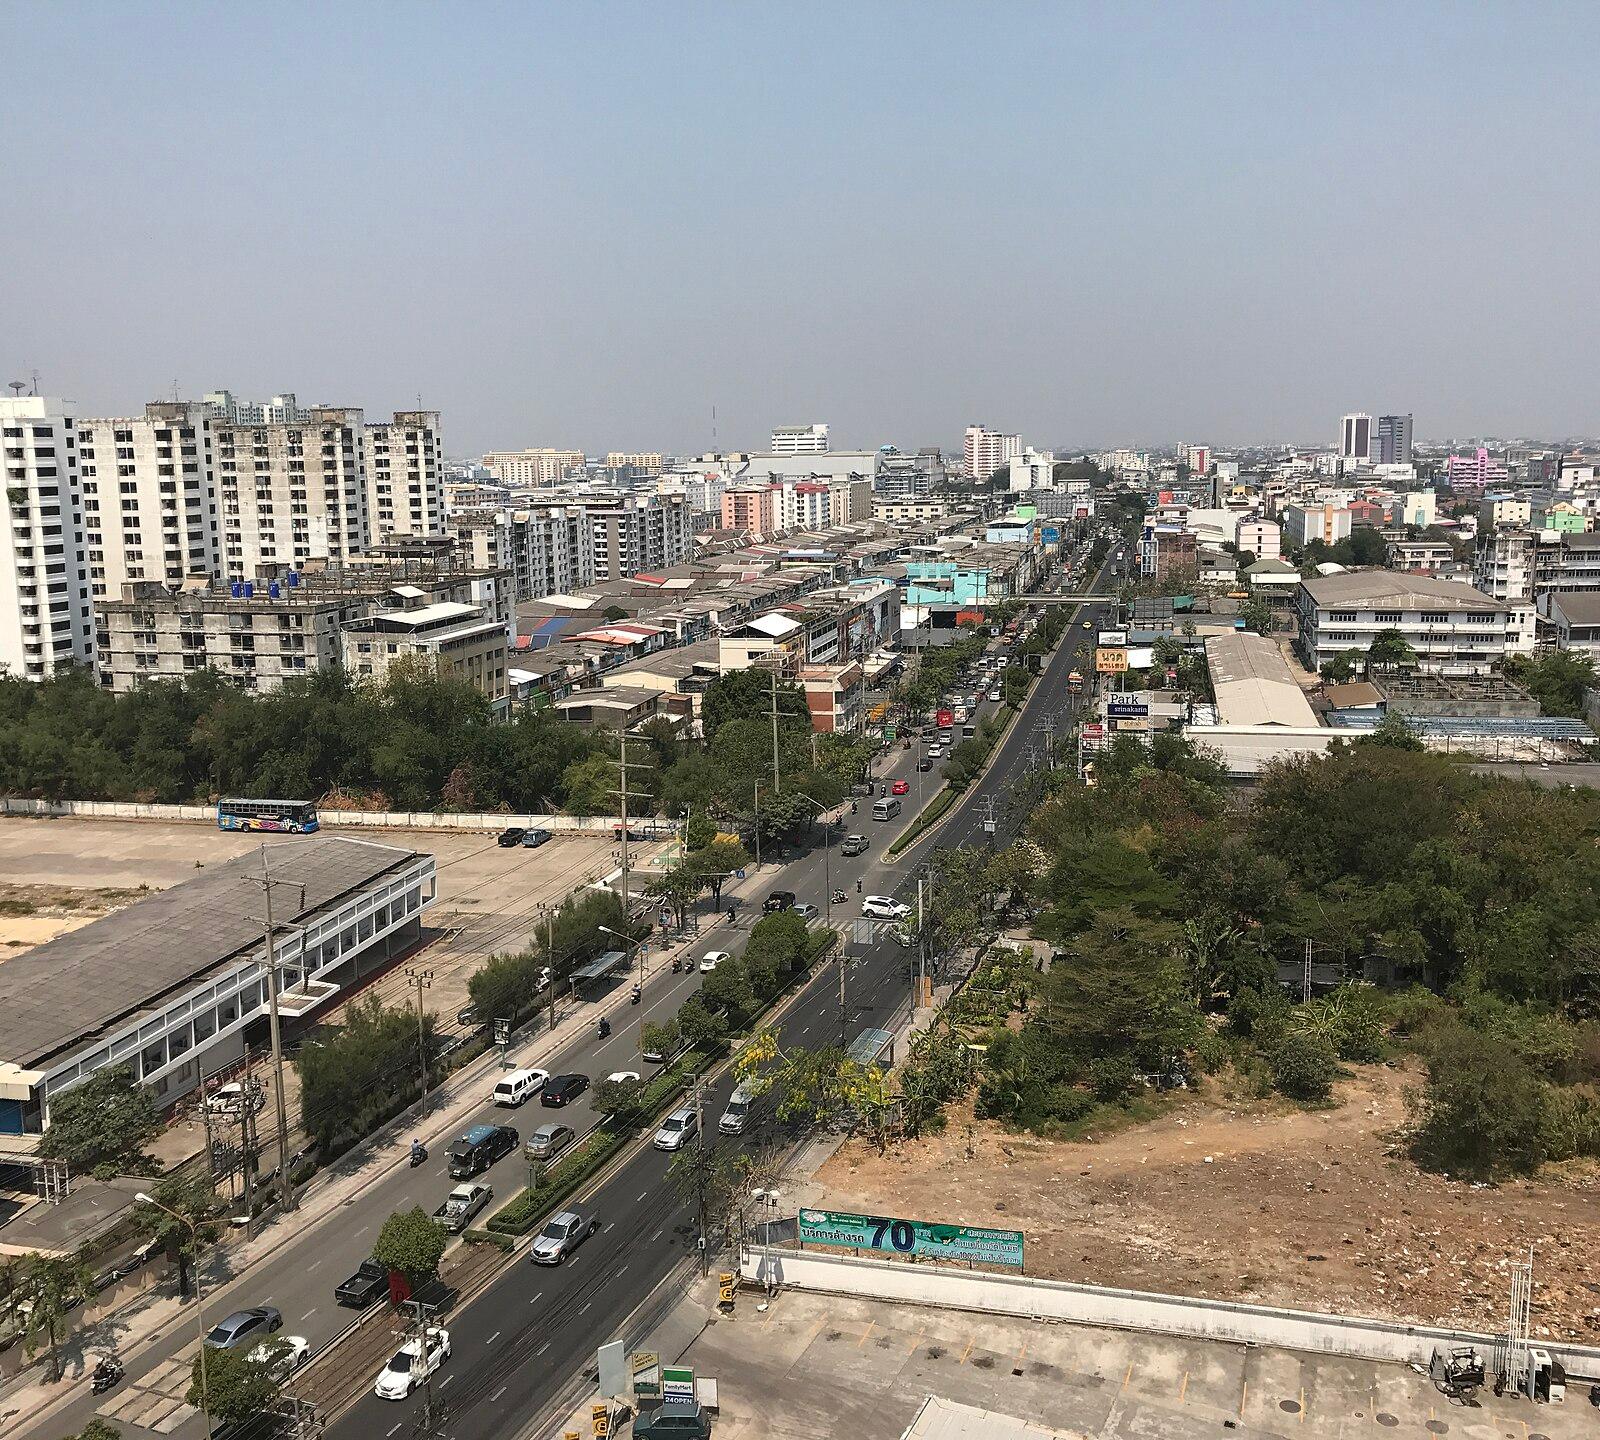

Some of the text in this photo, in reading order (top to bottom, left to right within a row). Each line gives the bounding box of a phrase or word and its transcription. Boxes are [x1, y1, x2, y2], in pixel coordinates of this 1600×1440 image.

[1110, 694, 1139, 704] Park
[802, 1227, 864, 1243] บริการล้างรถ
[867, 1216, 915, 1253] 70
